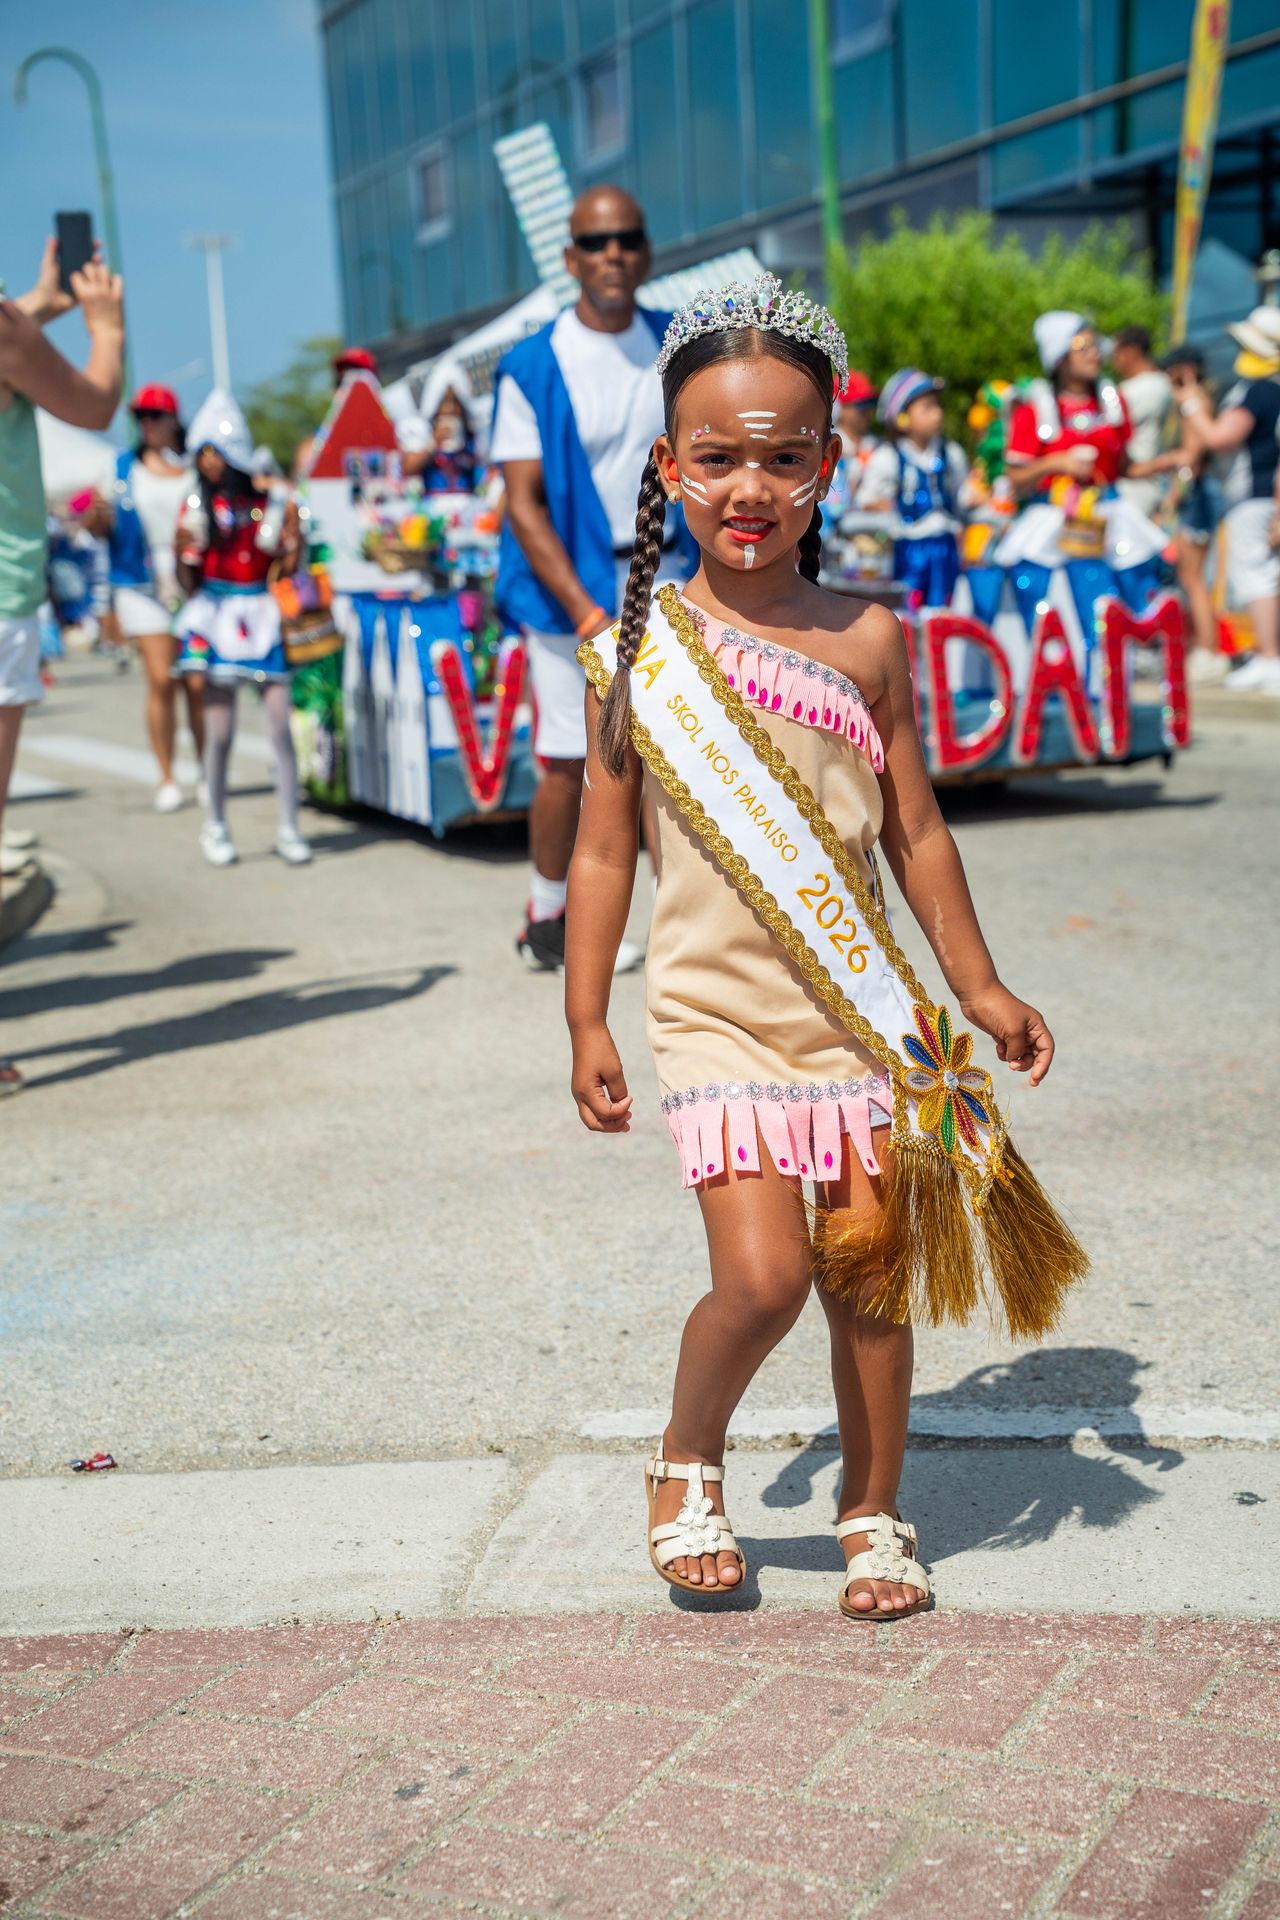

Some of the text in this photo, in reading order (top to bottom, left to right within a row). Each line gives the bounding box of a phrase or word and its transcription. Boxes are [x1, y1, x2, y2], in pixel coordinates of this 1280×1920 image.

[667, 694, 871, 974] SKOL NOS PARAISO 2026
